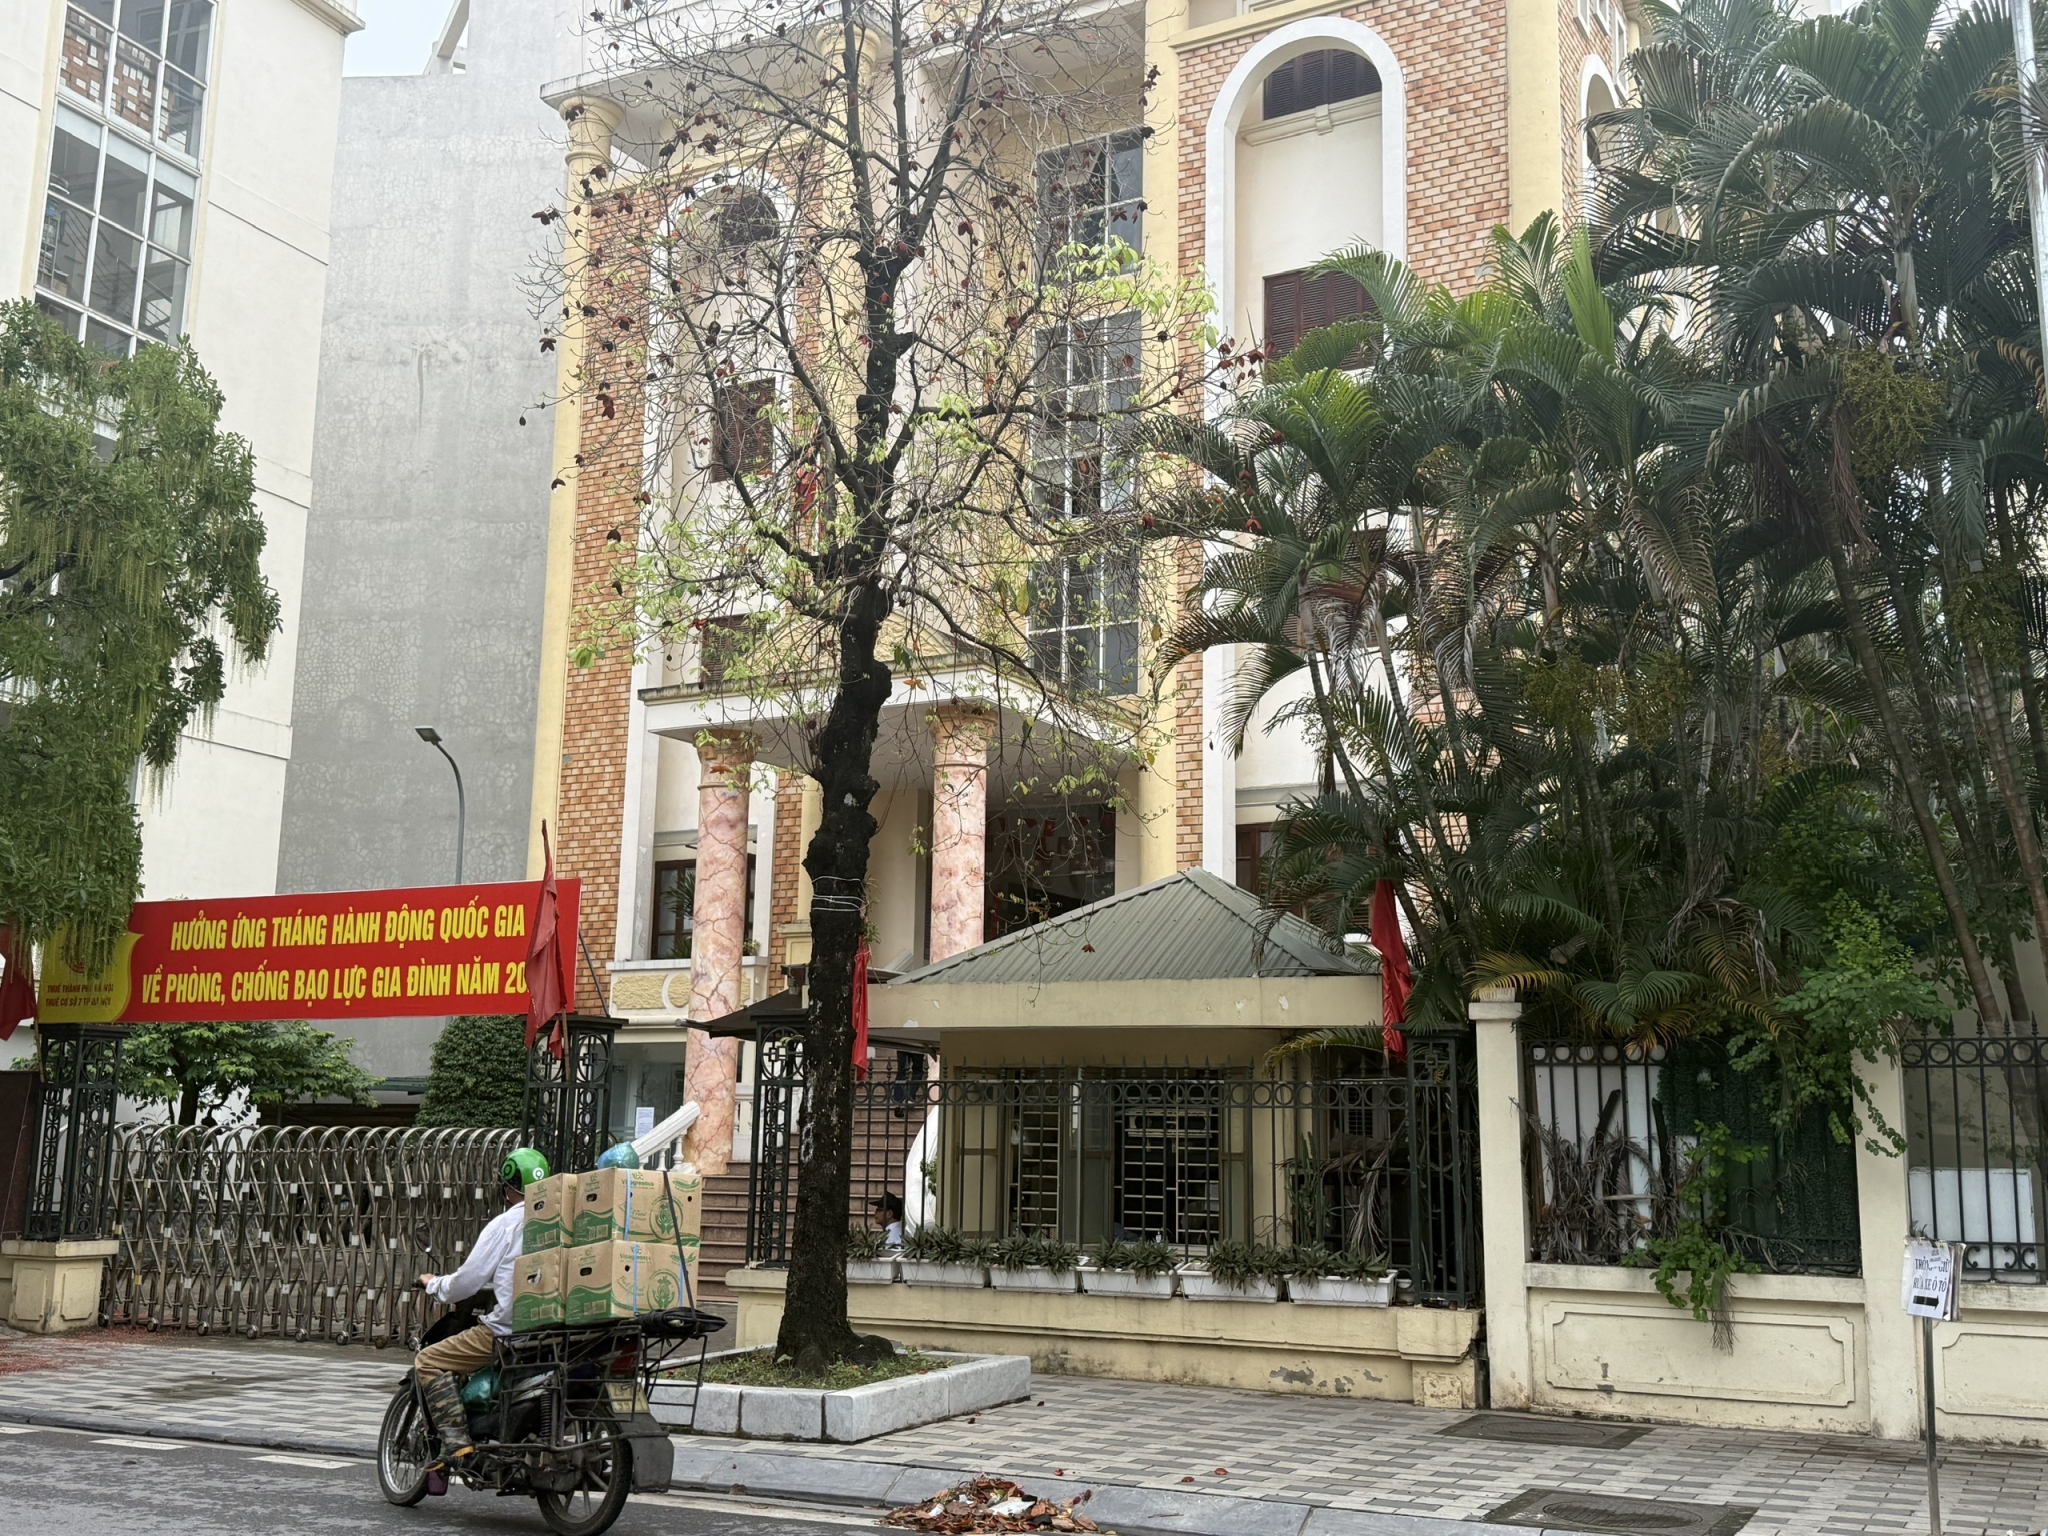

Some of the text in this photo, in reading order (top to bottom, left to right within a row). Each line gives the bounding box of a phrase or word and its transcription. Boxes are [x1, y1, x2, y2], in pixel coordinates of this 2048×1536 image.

[170, 895, 525, 951] HƯỞNG ỨNG THÁNG HÀNH ĐỘNG QUỐC GIA
[142, 955, 530, 1008] VỀ PHÒNG, CHỐNG BẠO LỰC GIA ĐÌNH NĂM 20
